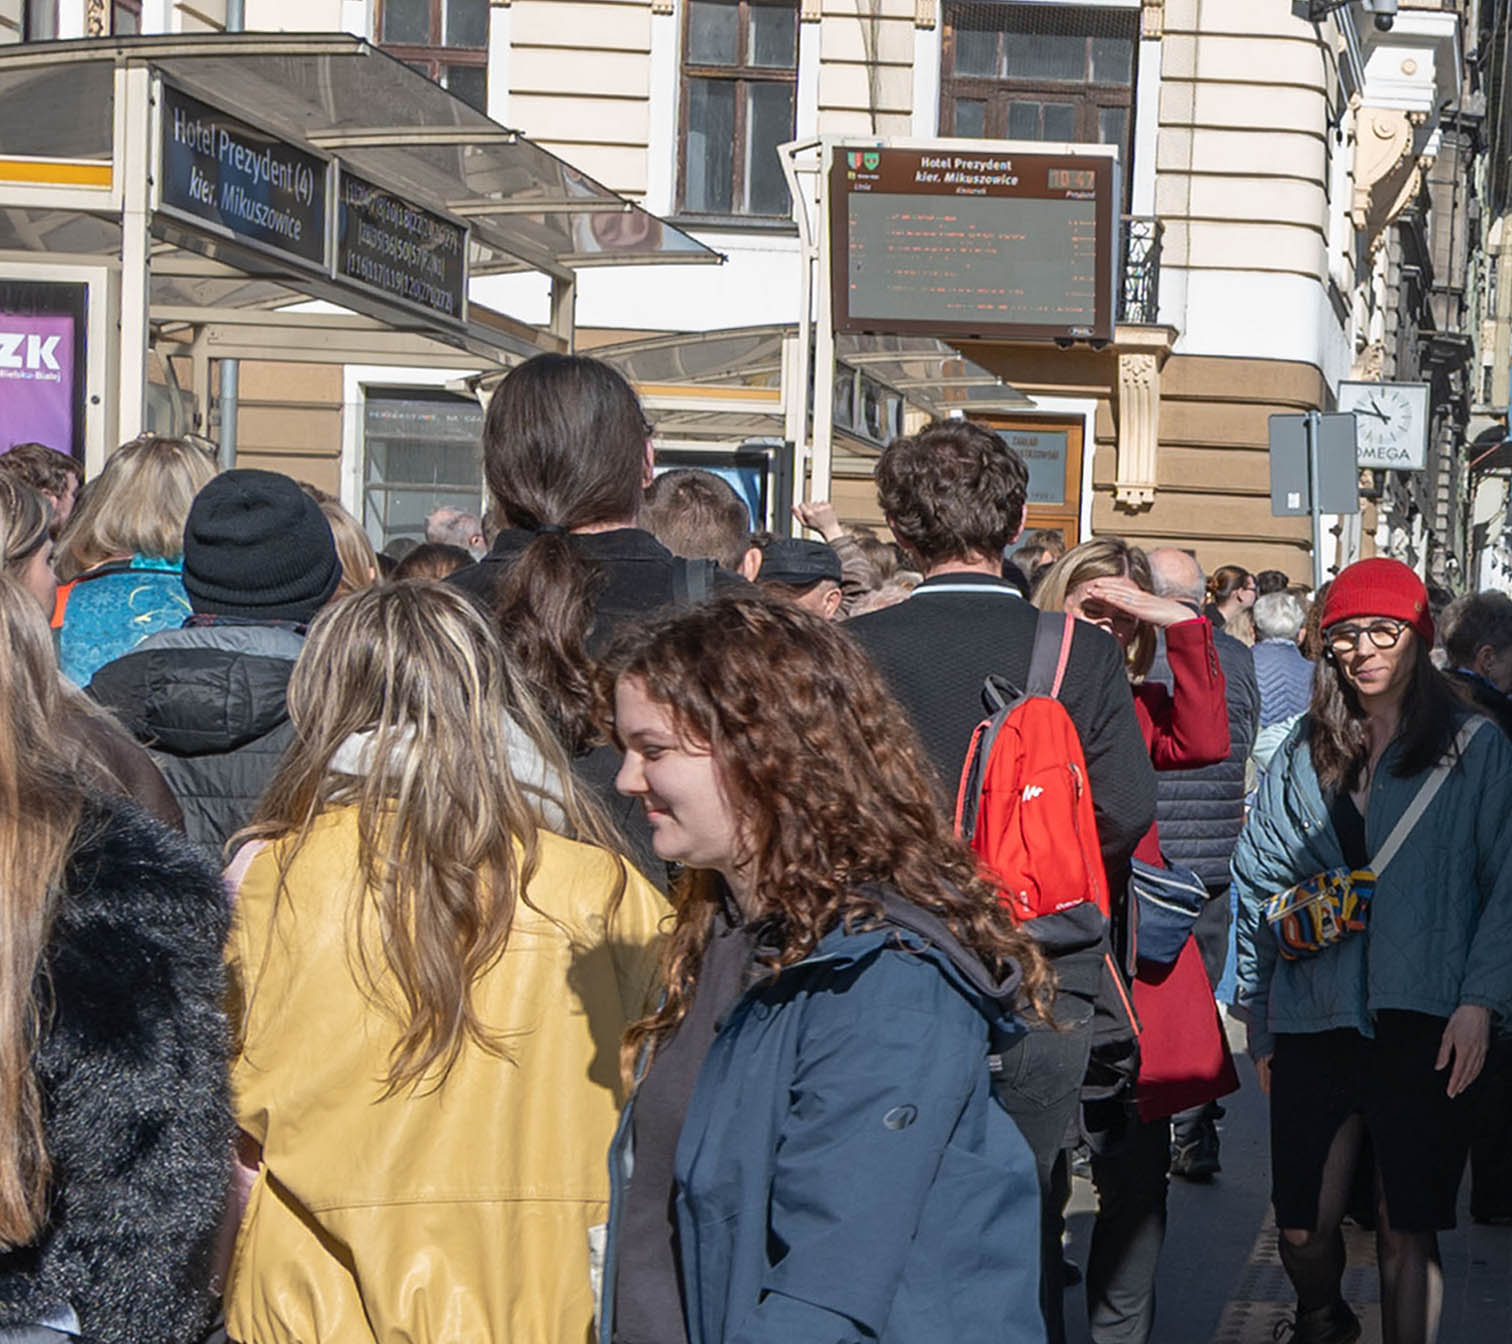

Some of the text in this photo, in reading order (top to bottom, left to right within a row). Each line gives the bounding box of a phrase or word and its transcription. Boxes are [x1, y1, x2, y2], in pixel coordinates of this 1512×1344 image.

[174, 107, 314, 206] Hotel Prezydent (4)
[914, 170, 942, 184] kier.
[944, 172, 1019, 186] Mikuszowice
[920, 156, 1012, 172] Hotel Prezydent
[189, 166, 218, 207] kier.
[220, 182, 302, 241] Mikuszowice
